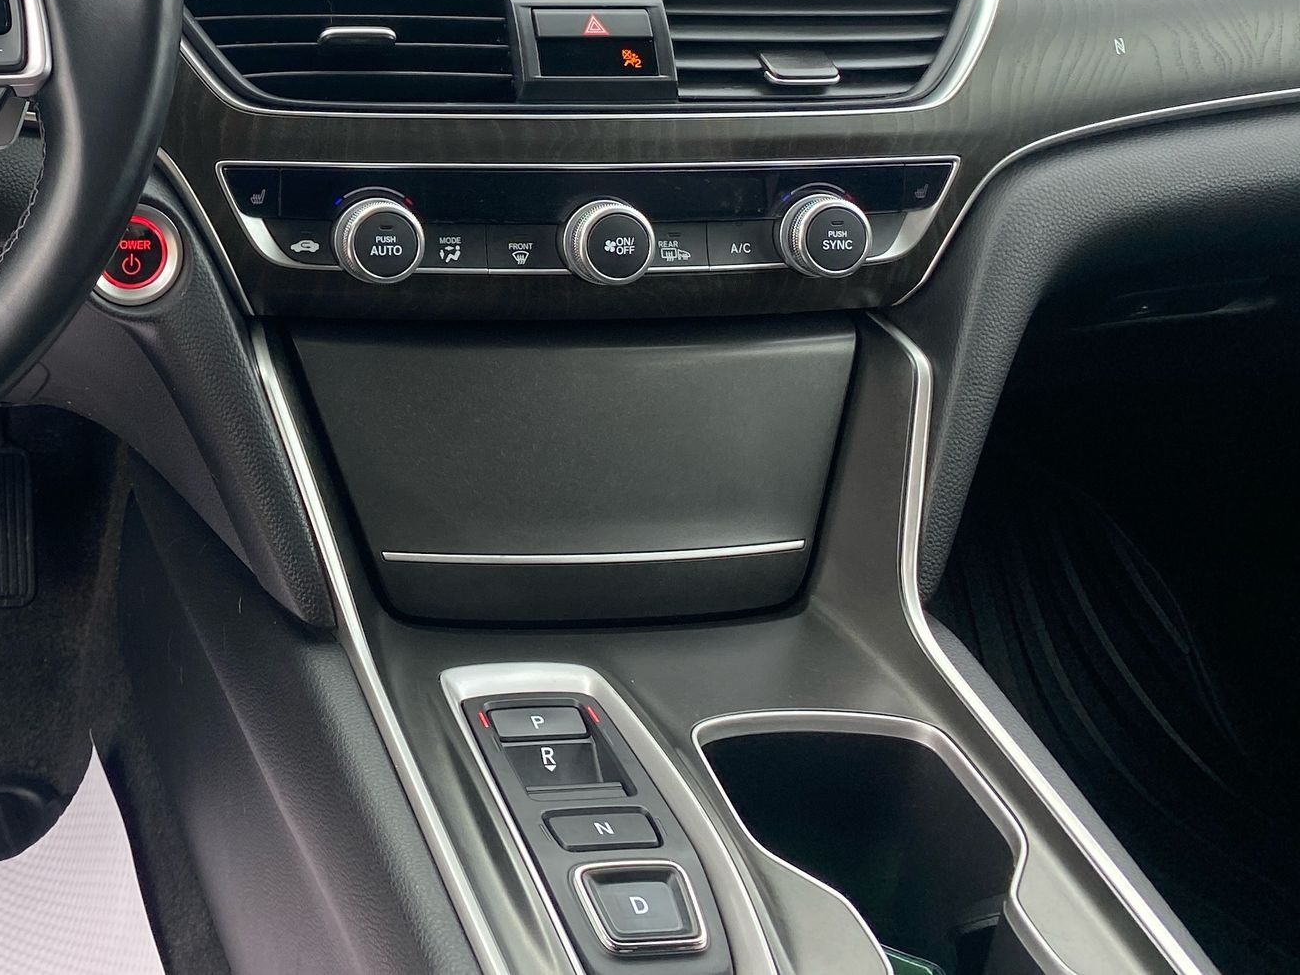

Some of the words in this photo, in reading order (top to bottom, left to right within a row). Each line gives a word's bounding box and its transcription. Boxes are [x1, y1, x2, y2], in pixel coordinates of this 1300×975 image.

[828, 230, 848, 238] PUSH
[375, 235, 397, 244] PUSH
[439, 236, 462, 245] MODE
[616, 237, 635, 246] ON/
[658, 240, 679, 248] REAR
[119, 240, 152, 250] OWER
[508, 242, 533, 251] FRONT
[616, 245, 636, 255] OFF
[730, 242, 752, 254] A/C
[822, 239, 853, 251] SYNC
[370, 245, 403, 256] AUTO
[530, 715, 546, 730] P
[540, 747, 557, 765] R
[593, 821, 616, 836] N
[629, 896, 649, 915] D
